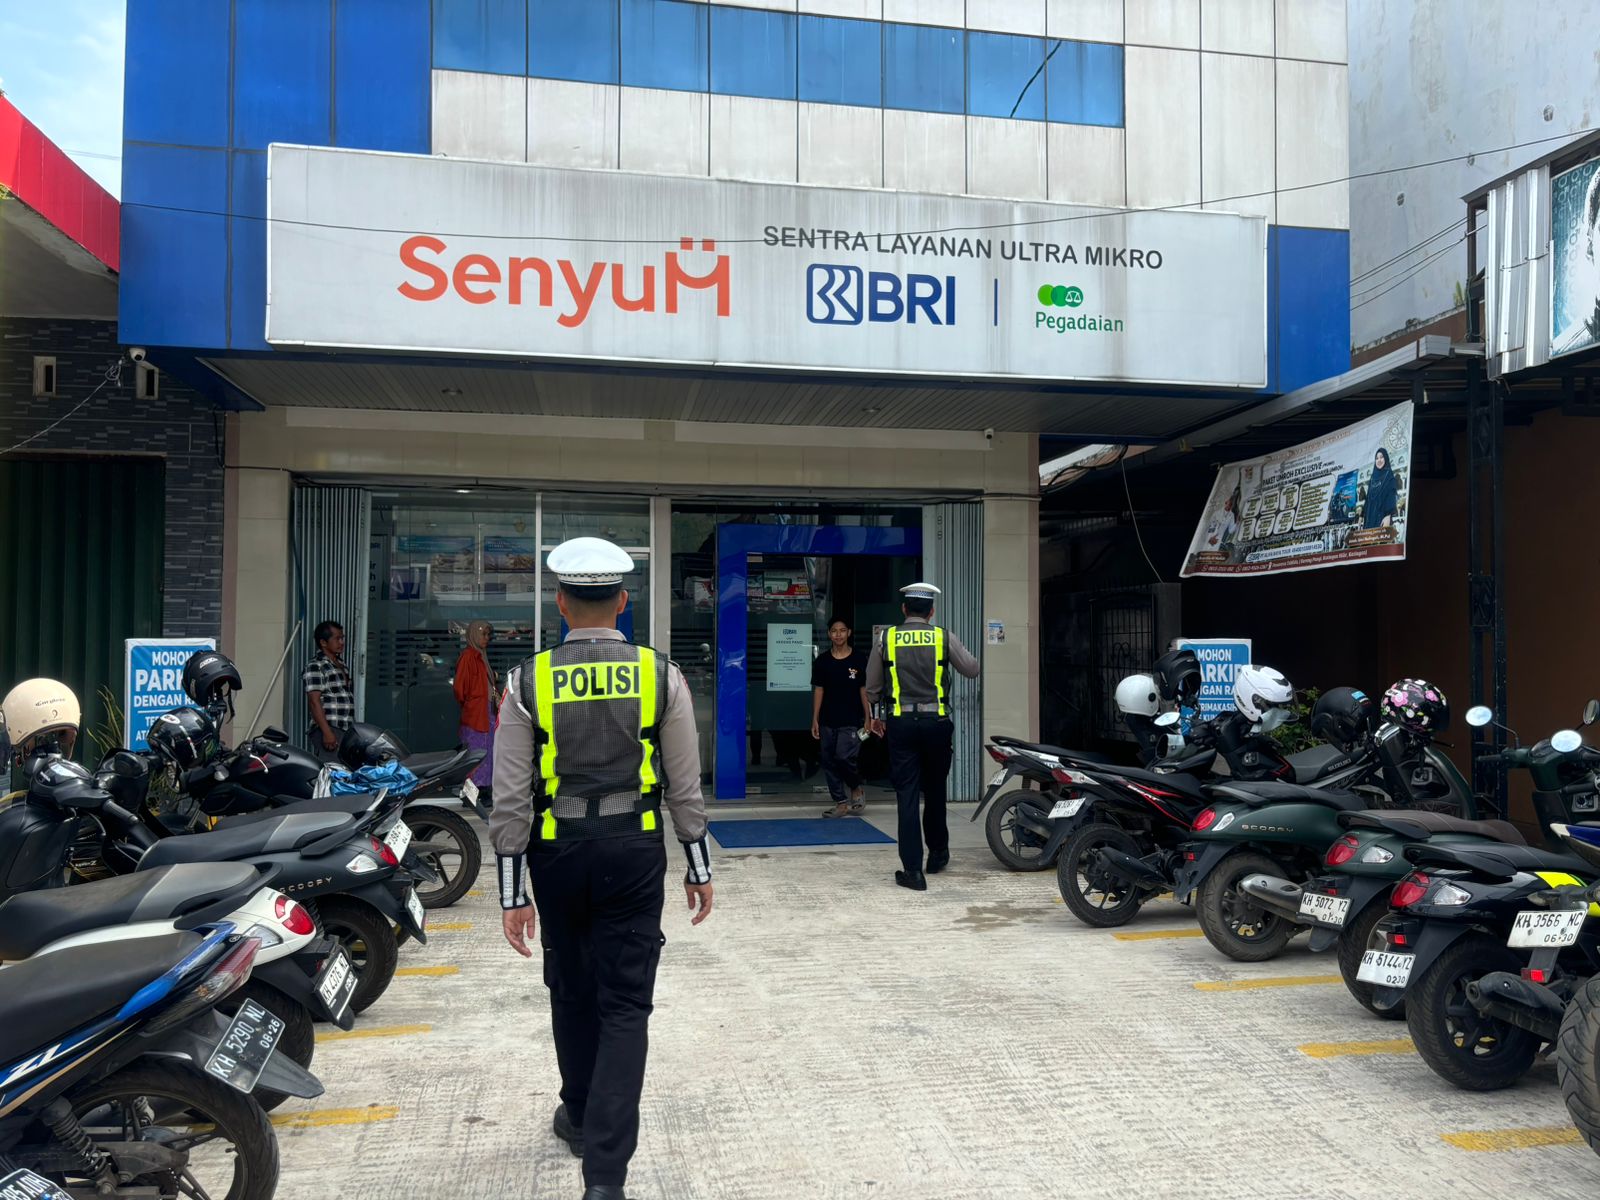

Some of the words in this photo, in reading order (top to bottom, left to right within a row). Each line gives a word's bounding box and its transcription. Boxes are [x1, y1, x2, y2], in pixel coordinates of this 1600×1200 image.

[763, 225, 868, 252] SENTRA
[876, 232, 992, 259] LAYANAN
[1000, 240, 1078, 264] ULTRA
[1085, 246, 1163, 270] MIKRO
[868, 271, 956, 326] BRI
[1035, 311, 1124, 334] Pegadaian
[1294, 461, 1323, 477] EXCLUSIVE
[895, 632, 935, 644] POLISI
[1197, 649, 1232, 661] MOHON
[552, 665, 640, 699] POLISI
[134, 694, 181, 707] DENGAN
[1303, 894, 1313, 905] KH
[1315, 896, 1334, 910] 5072
[1338, 900, 1348, 912] YZ
[1515, 914, 1532, 928] KH
[1533, 913, 1562, 927] 3566
[1567, 912, 1583, 927] NC
[1362, 952, 1375, 965] KH
[1376, 953, 1399, 968] 5144
[1401, 956, 1413, 970] YZ
[211, 1053, 237, 1078] KH
[225, 1021, 255, 1053] 5290
[244, 1005, 266, 1023] NL
